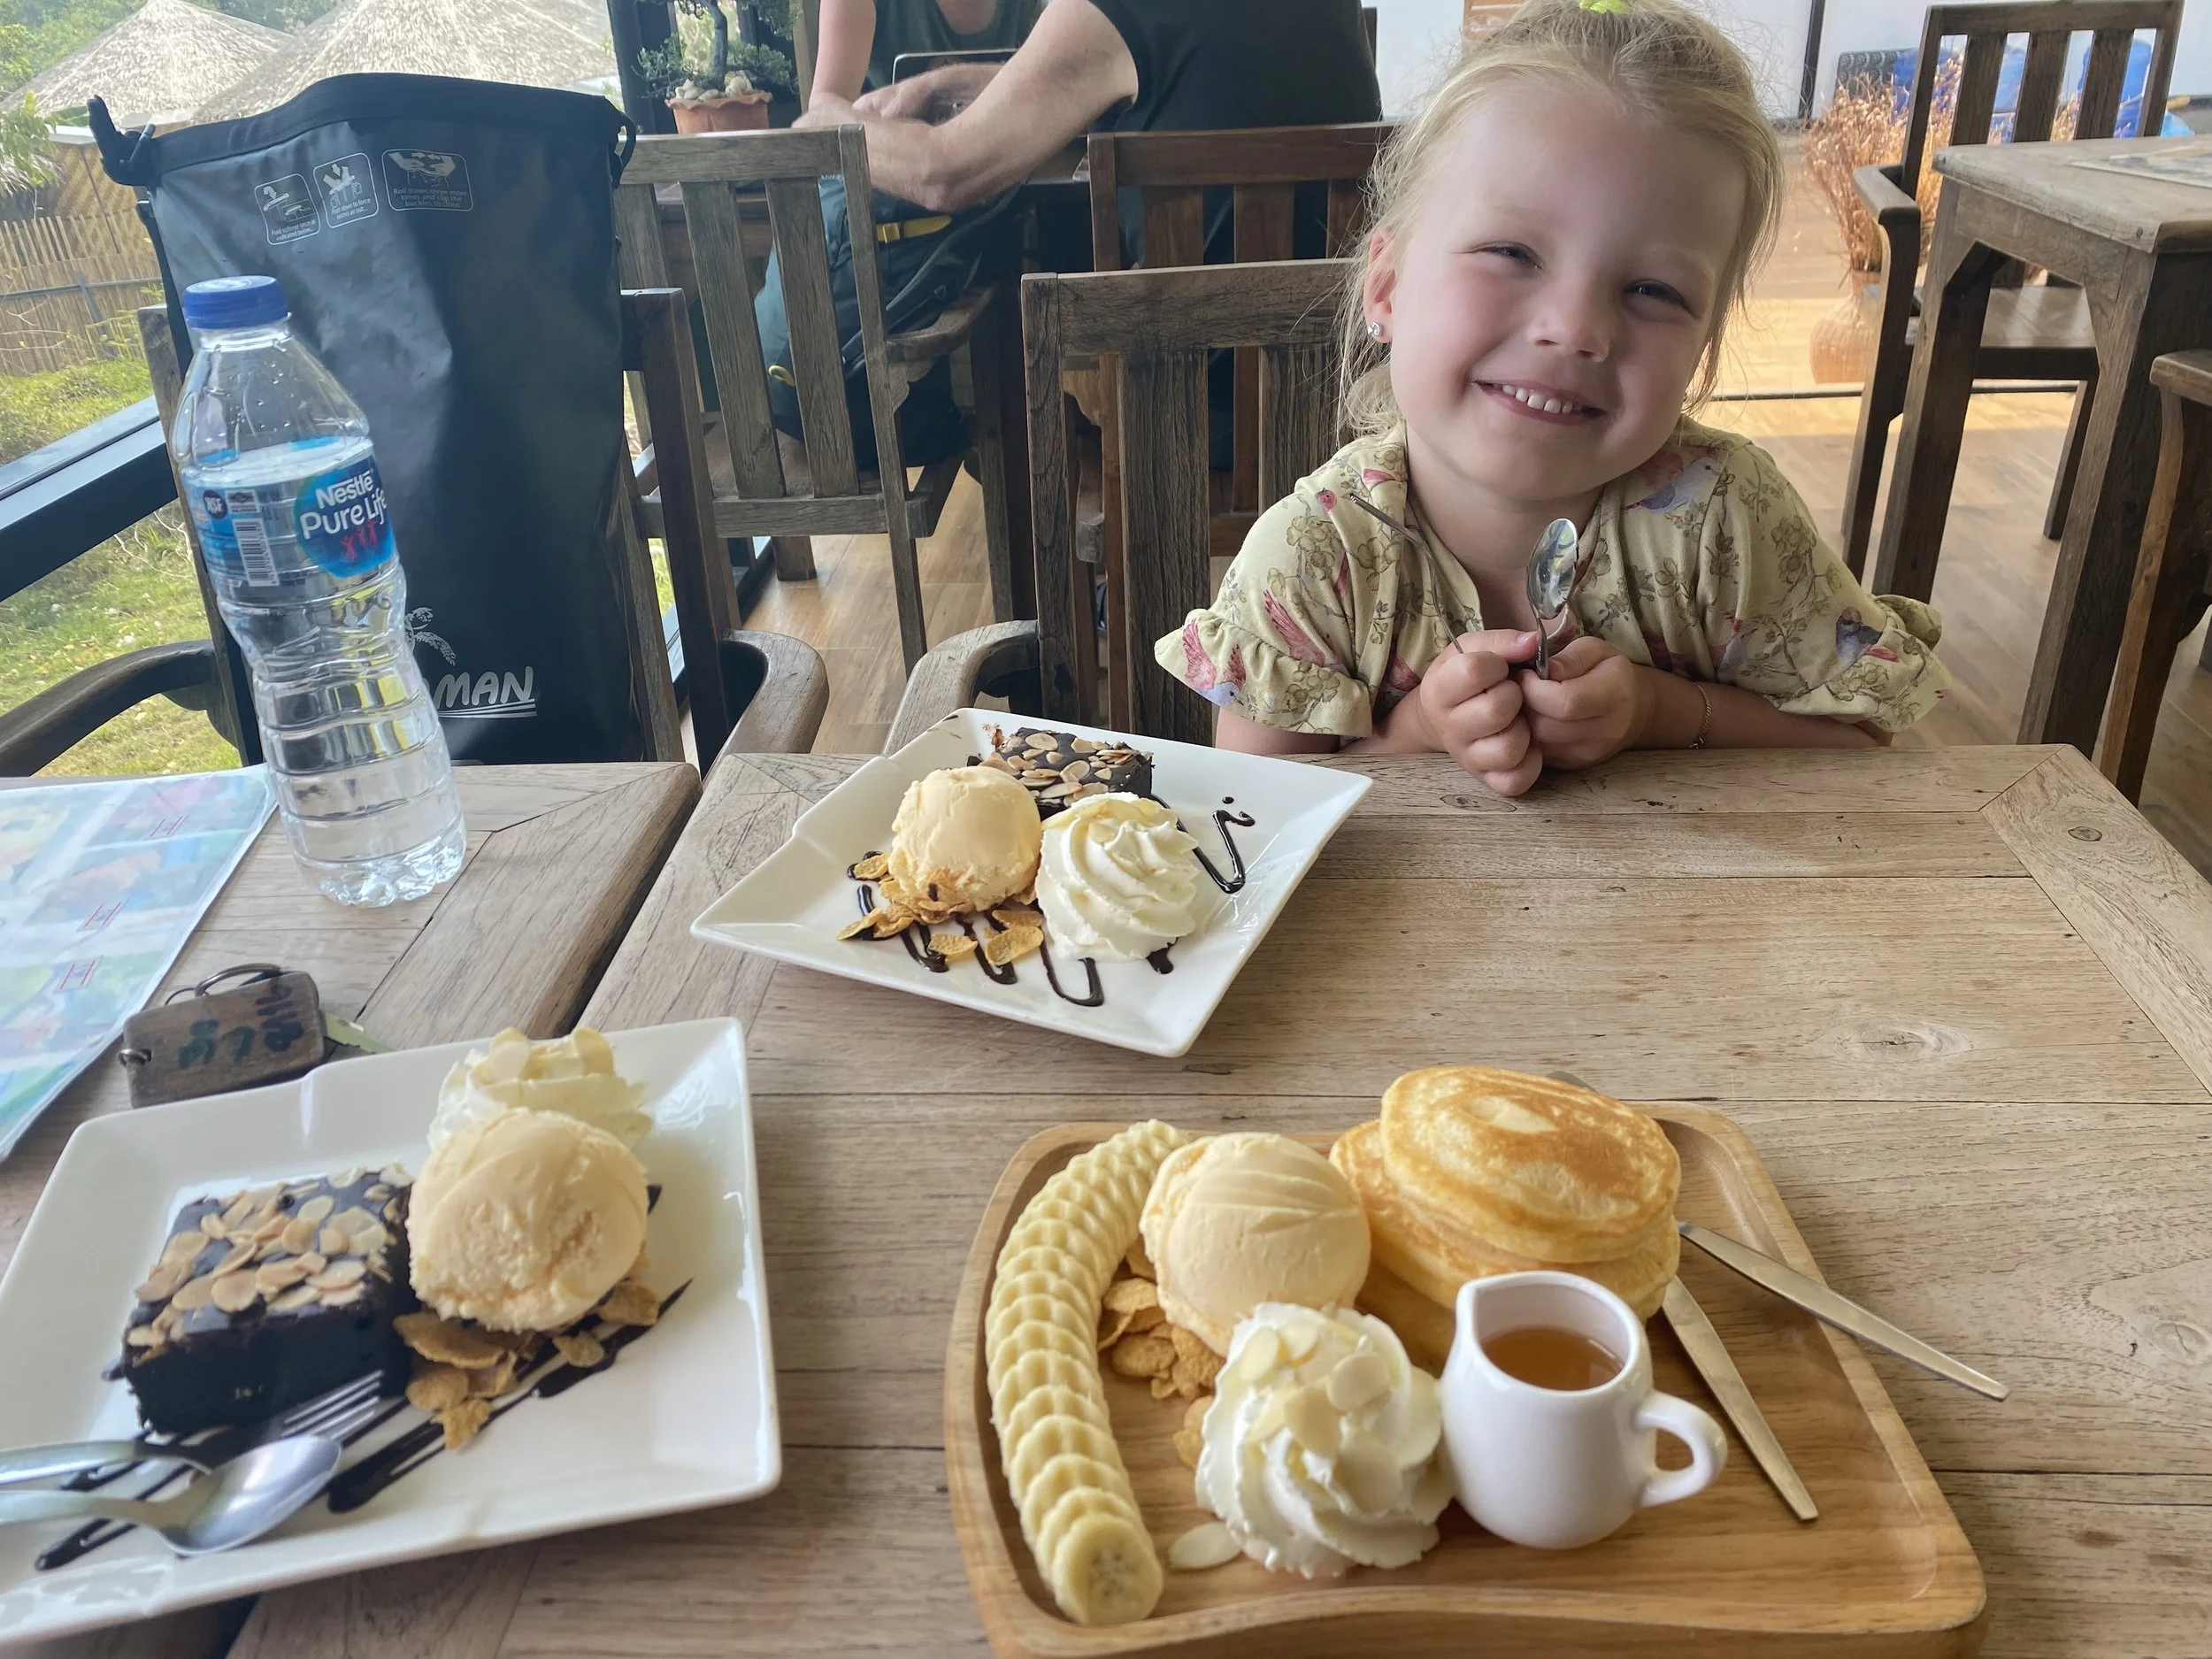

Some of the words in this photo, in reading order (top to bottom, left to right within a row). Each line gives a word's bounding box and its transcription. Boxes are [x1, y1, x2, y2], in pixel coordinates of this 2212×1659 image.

[299, 503, 365, 540] Pure
[364, 488, 388, 525] Life
[424, 665, 534, 709] MAN
